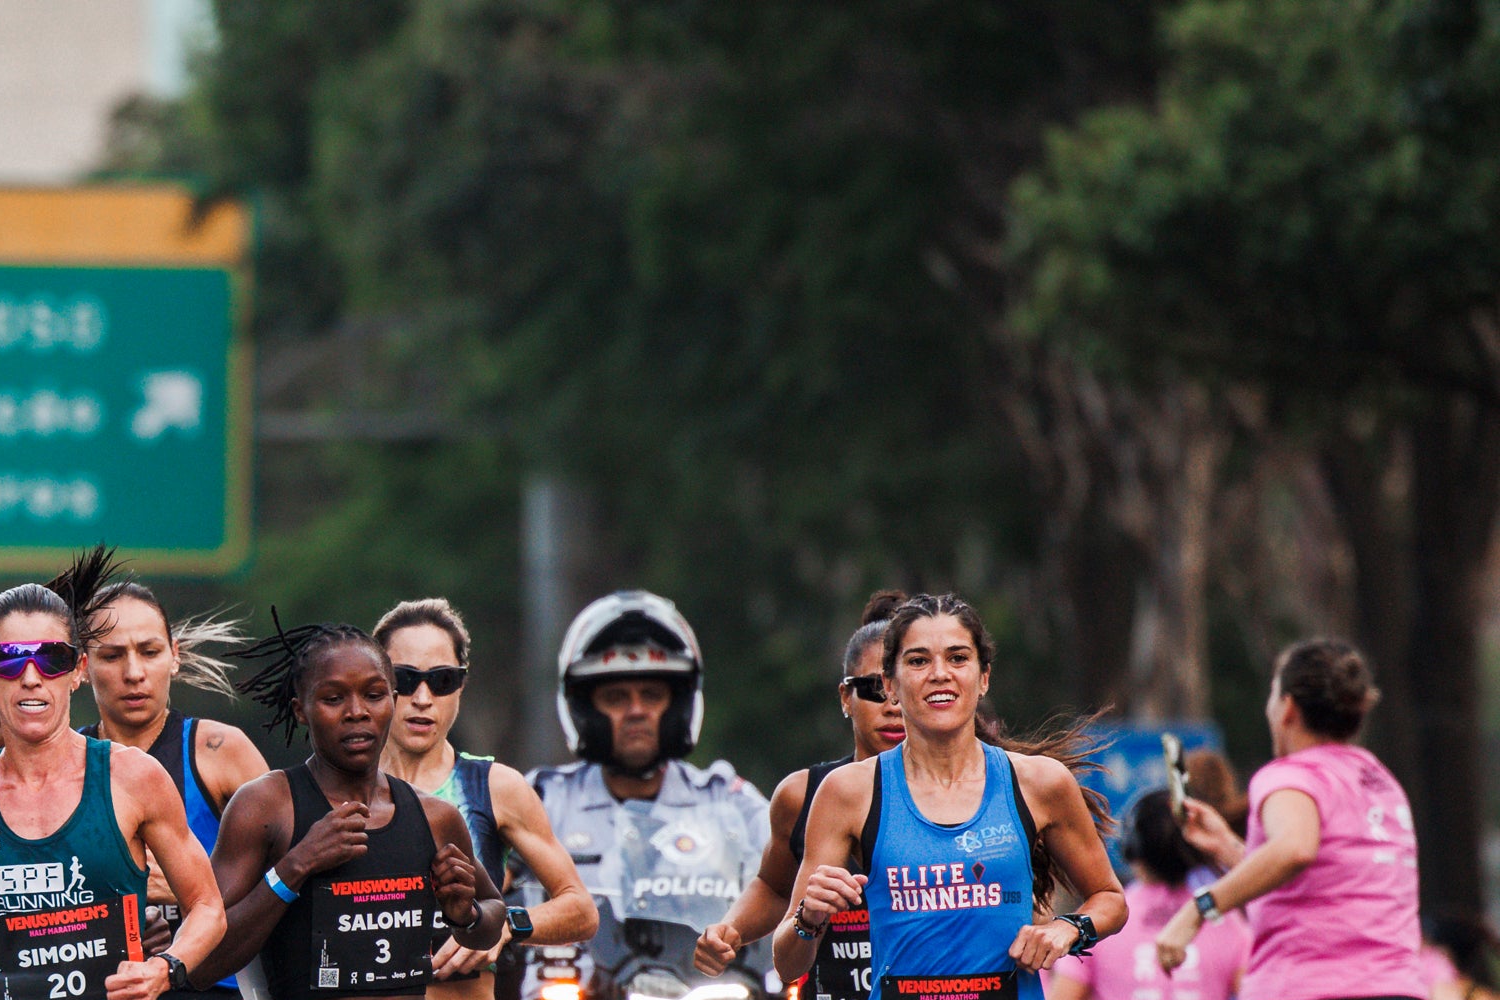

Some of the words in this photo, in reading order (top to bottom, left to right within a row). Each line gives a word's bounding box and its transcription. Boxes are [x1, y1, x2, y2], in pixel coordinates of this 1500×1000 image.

[2, 864, 59, 893] SPF
[331, 875, 424, 896] VENUSWOMEN'S
[886, 862, 966, 888] ELITE
[353, 894, 370, 903] HALF
[370, 892, 406, 902] MARATHON
[890, 882, 1002, 912] RUNNERS
[5, 903, 109, 932] VENUSWOMEN'S
[337, 909, 423, 933] SALOME
[847, 923, 870, 931] MARAT
[29, 927, 47, 938] HALF
[47, 922, 88, 936] MARATHON
[17, 938, 108, 968] SIMONE
[375, 938, 392, 964] 3
[831, 941, 872, 959] NUB
[47, 970, 87, 999] 20
[897, 977, 1002, 994] VENUSWOMEN'S
[939, 993, 979, 1000] MARATHON
